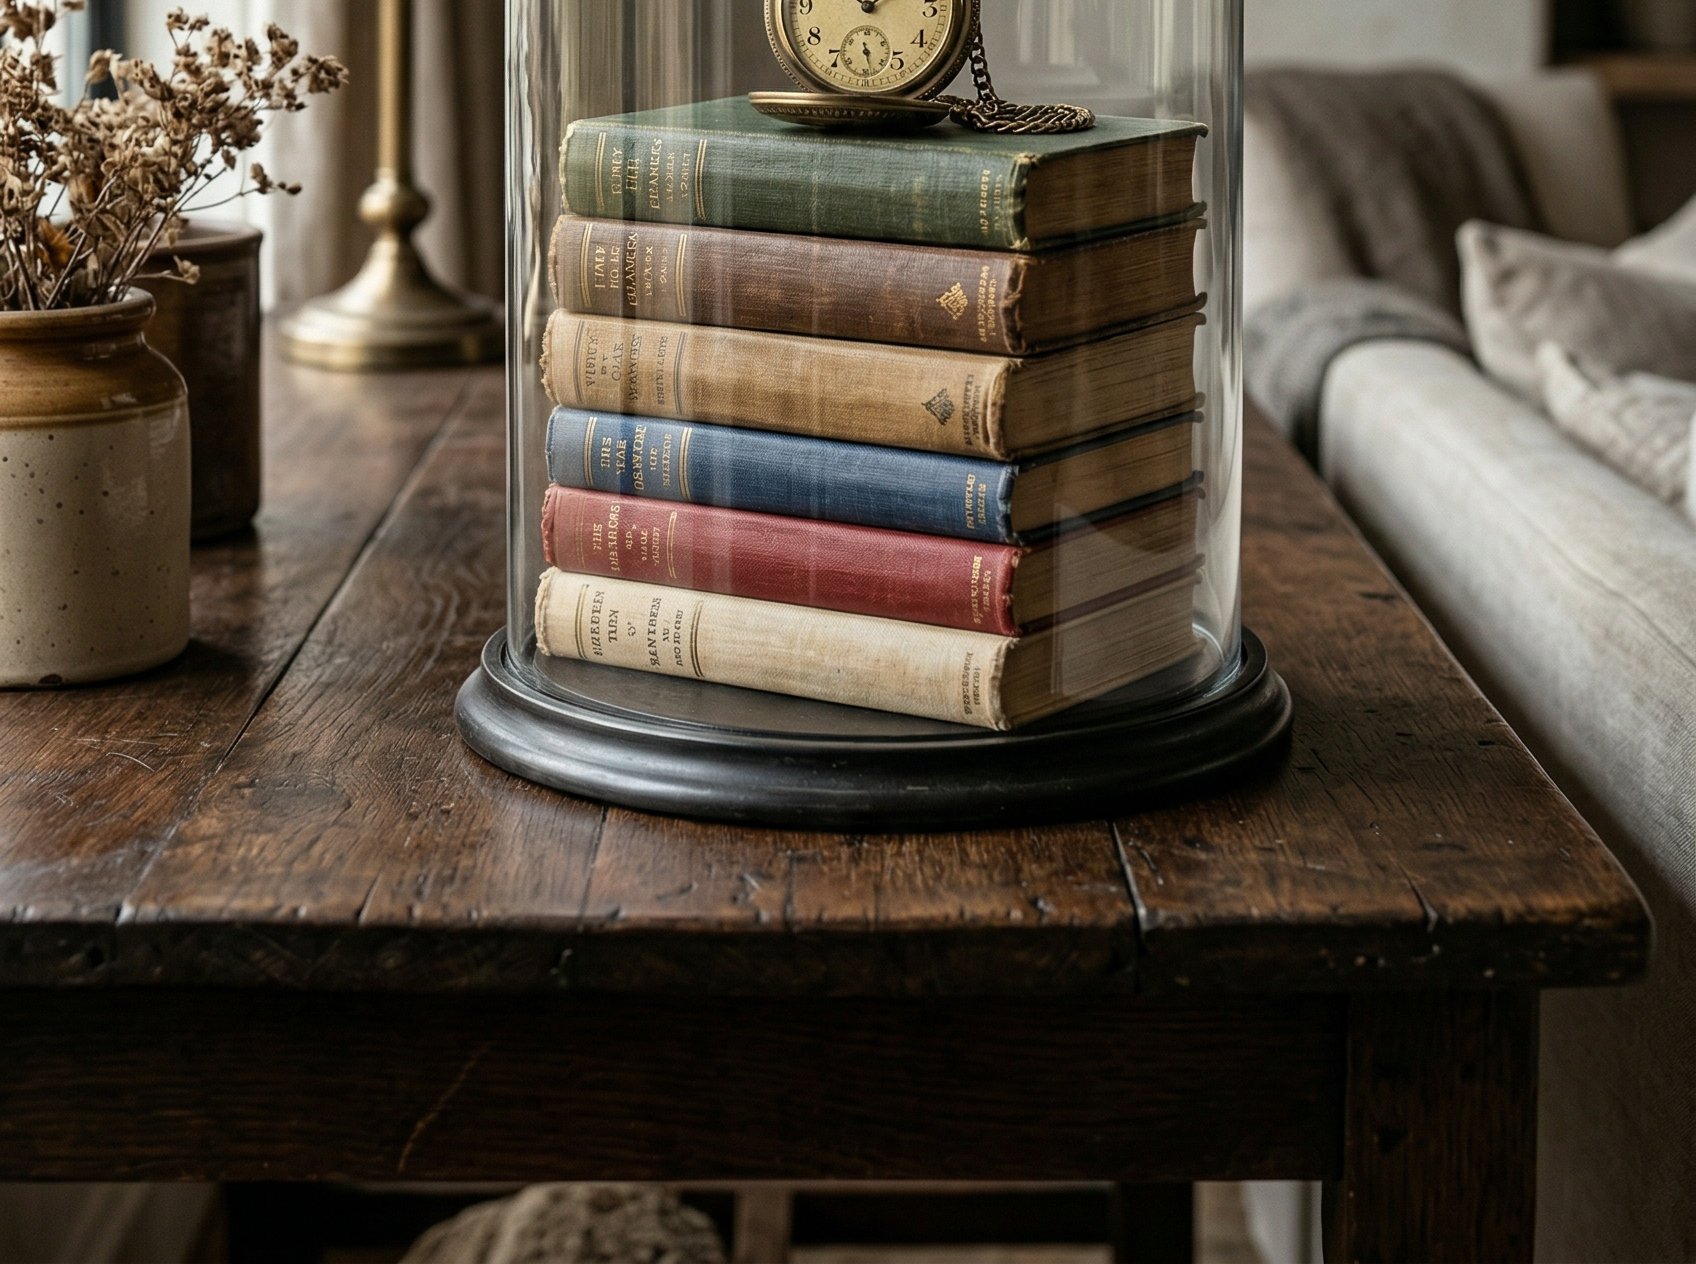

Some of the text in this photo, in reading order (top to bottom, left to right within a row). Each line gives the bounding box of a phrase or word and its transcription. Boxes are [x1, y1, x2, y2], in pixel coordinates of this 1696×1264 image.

[922, 0, 938, 18] 3
[807, 26, 821, 46] 8
[909, 29, 928, 48] 4
[828, 49, 841, 68] 7
[890, 51, 904, 71] 5
